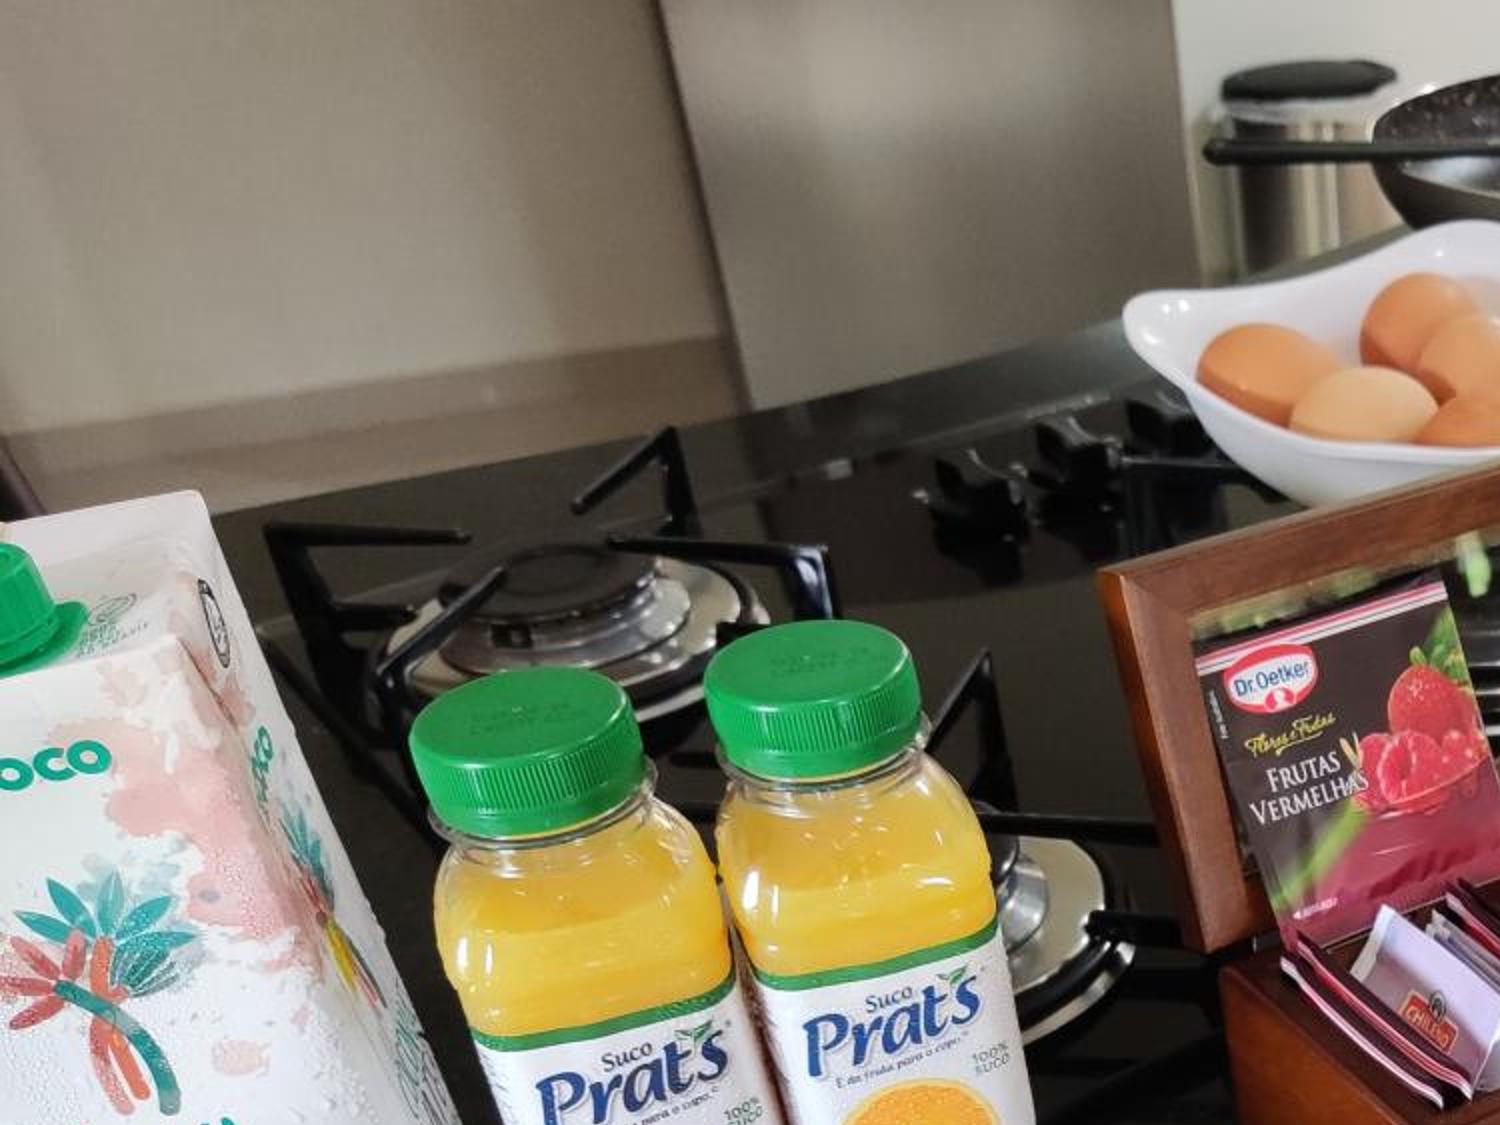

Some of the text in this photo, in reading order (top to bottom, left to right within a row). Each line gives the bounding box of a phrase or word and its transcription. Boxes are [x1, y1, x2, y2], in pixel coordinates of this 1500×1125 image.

[1266, 750, 1342, 793] FRUTAS
[1250, 769, 1369, 826] VERMELHAS
[864, 986, 913, 1014] Suco
[600, 1041, 654, 1073] Suco
